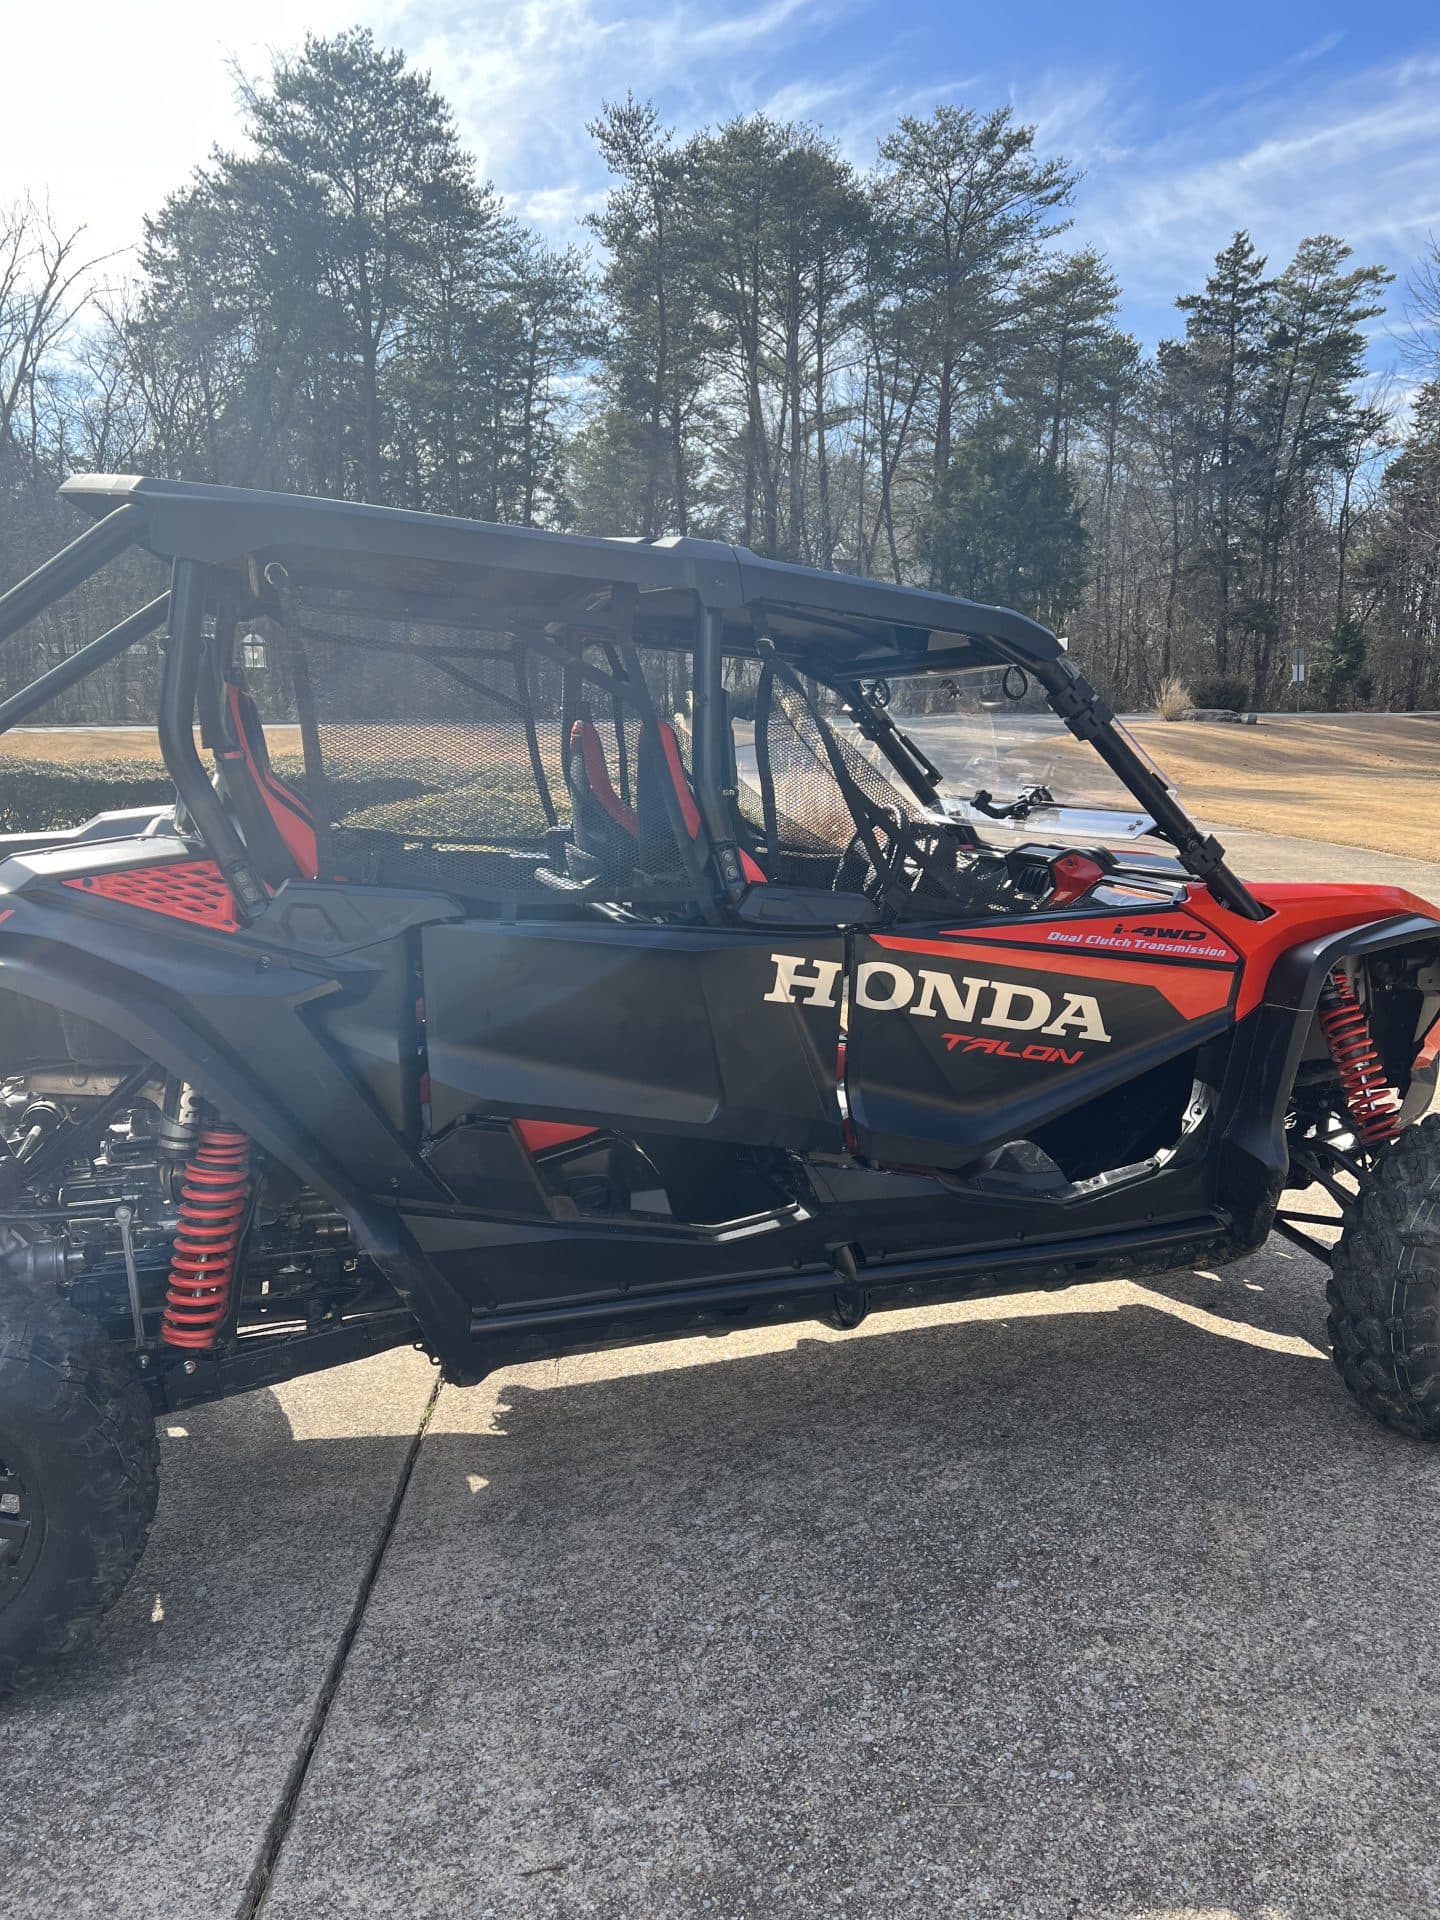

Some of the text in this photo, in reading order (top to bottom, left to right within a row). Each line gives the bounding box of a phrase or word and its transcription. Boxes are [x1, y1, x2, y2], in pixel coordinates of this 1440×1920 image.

[1047, 931, 1227, 958] Dual Clutch Transmission
[1113, 923, 1208, 942] i-4WD
[763, 953, 1113, 1043] HONDA
[941, 1033, 1085, 1065] TALON
